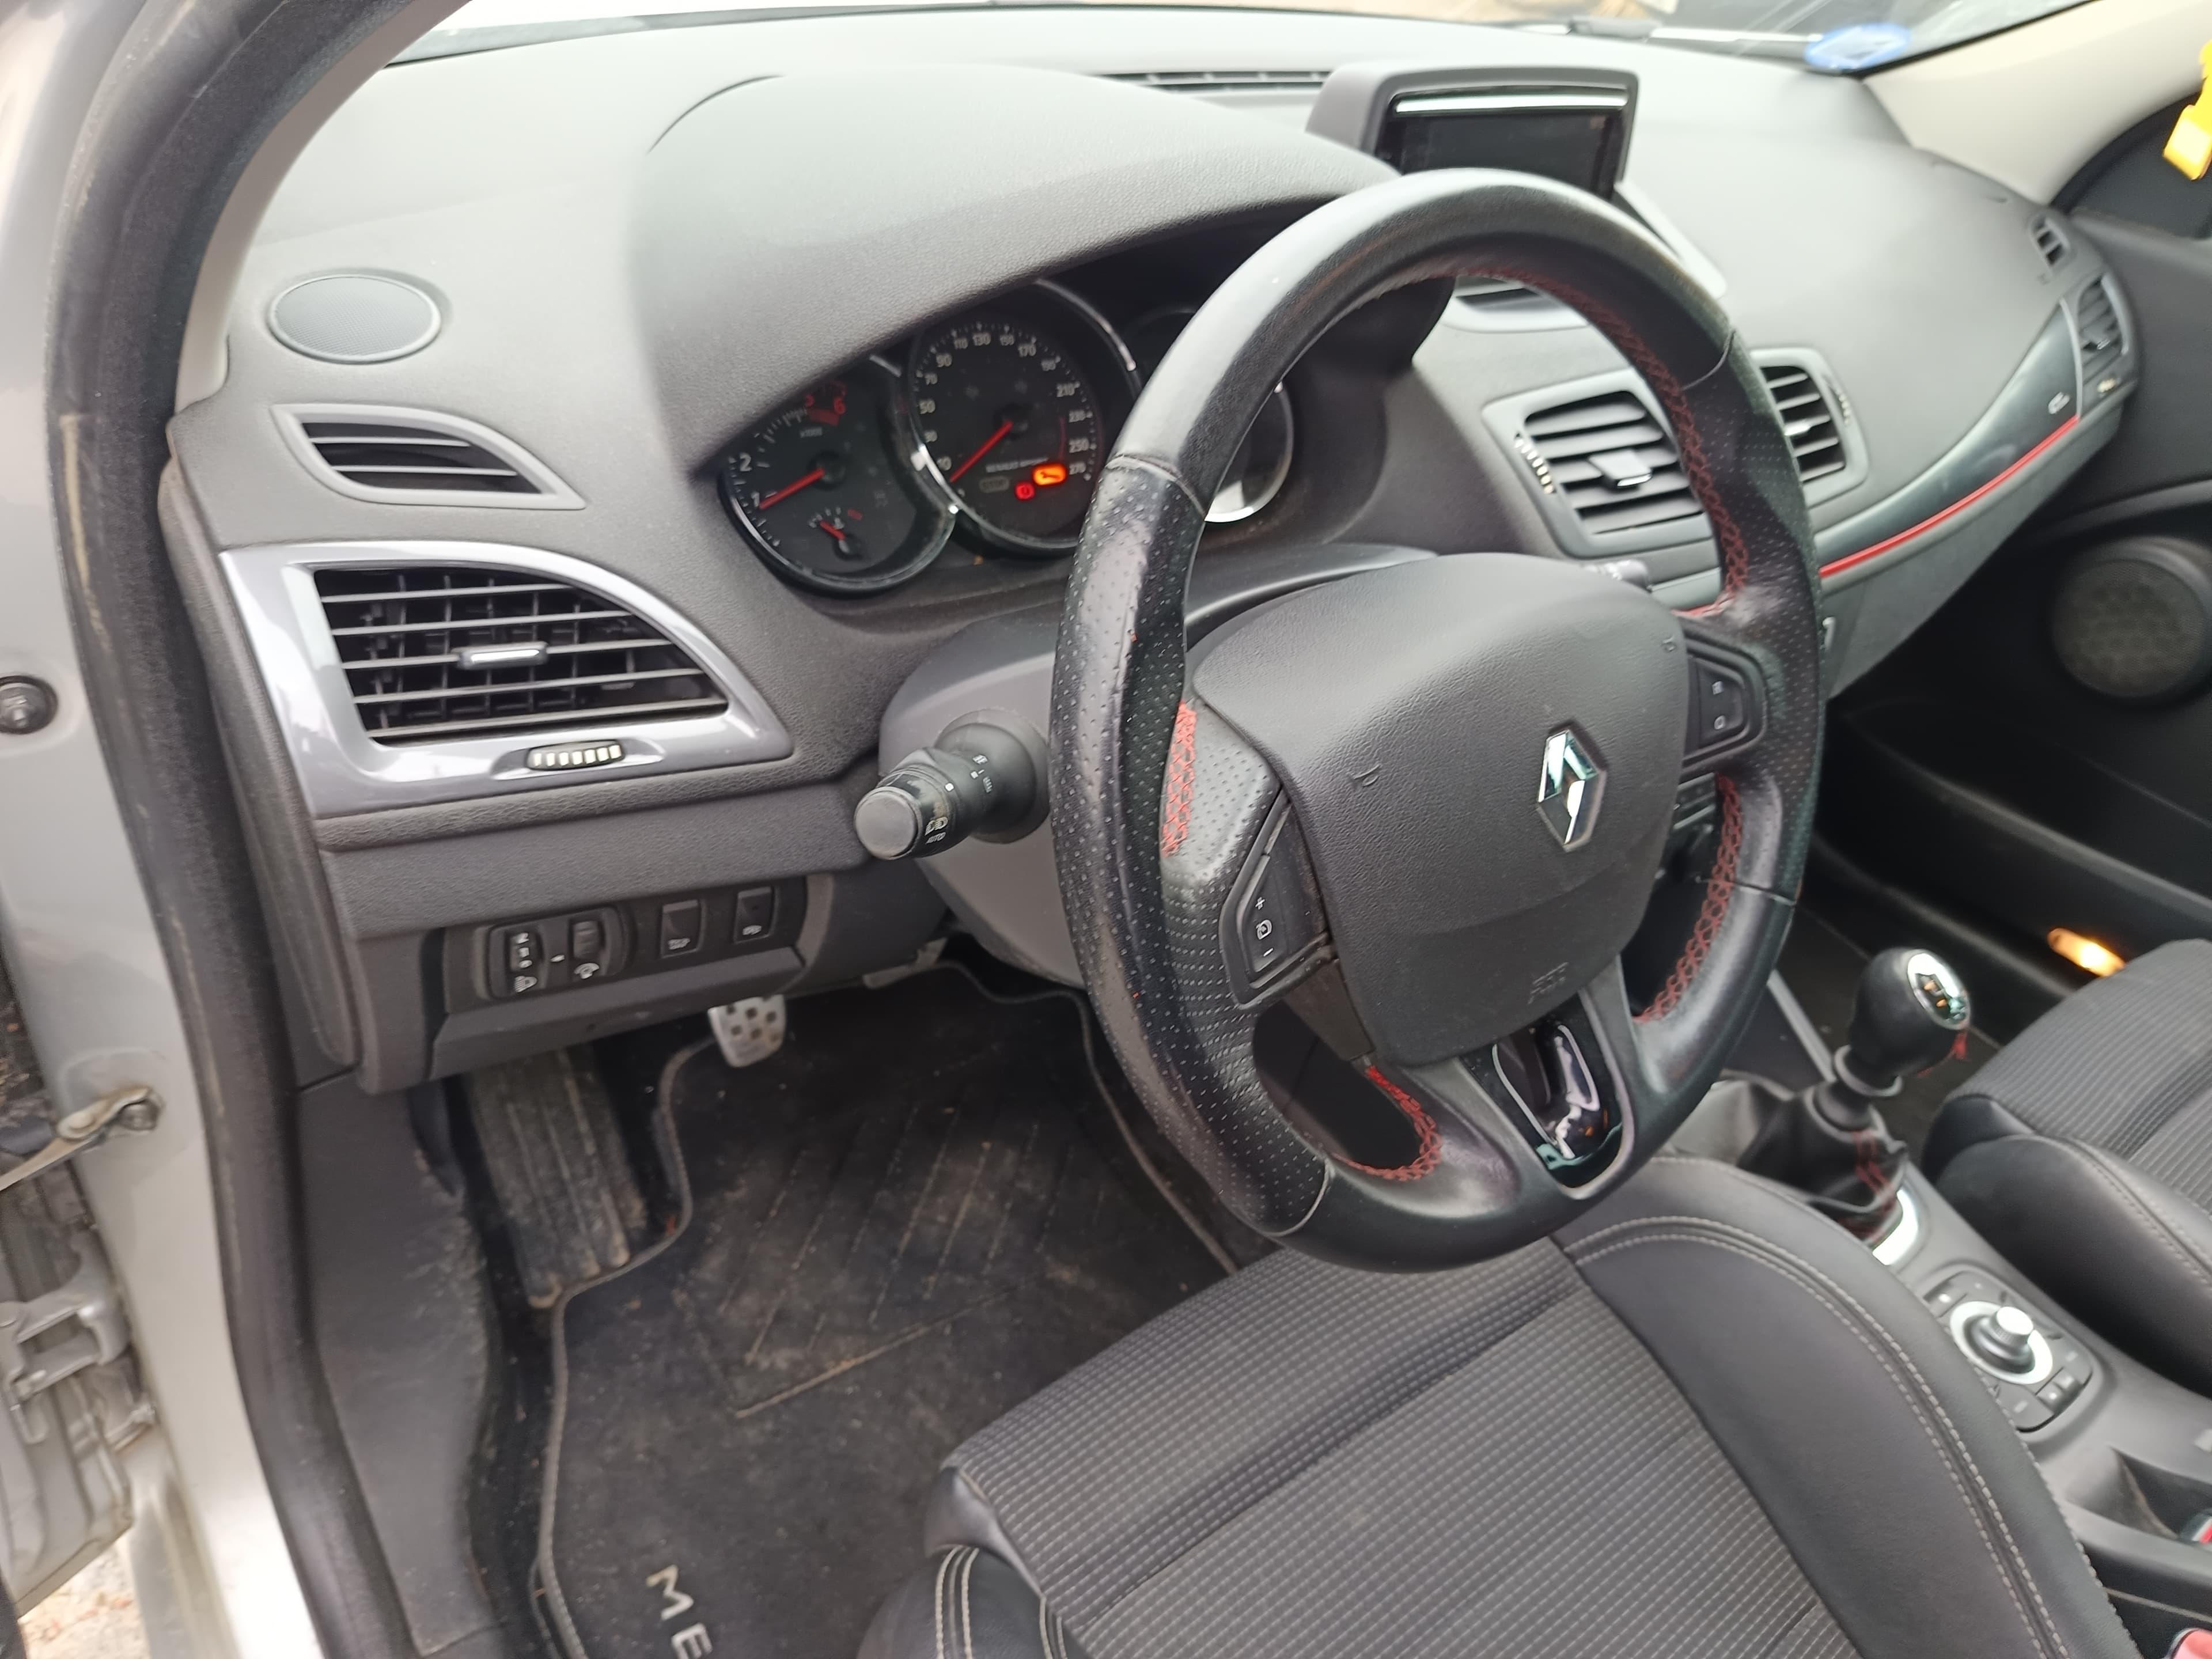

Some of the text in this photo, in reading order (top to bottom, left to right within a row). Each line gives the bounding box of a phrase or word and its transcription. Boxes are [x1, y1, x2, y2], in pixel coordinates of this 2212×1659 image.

[972, 332, 991, 346] 130
[1017, 343, 1036, 357] 170
[935, 353, 952, 367] 90
[925, 373, 938, 385] 70
[1056, 382, 1075, 397] 210
[919, 398, 935, 414] 50
[1069, 437, 1090, 453] 250
[740, 452, 752, 472] 2
[751, 491, 760, 507] 1
